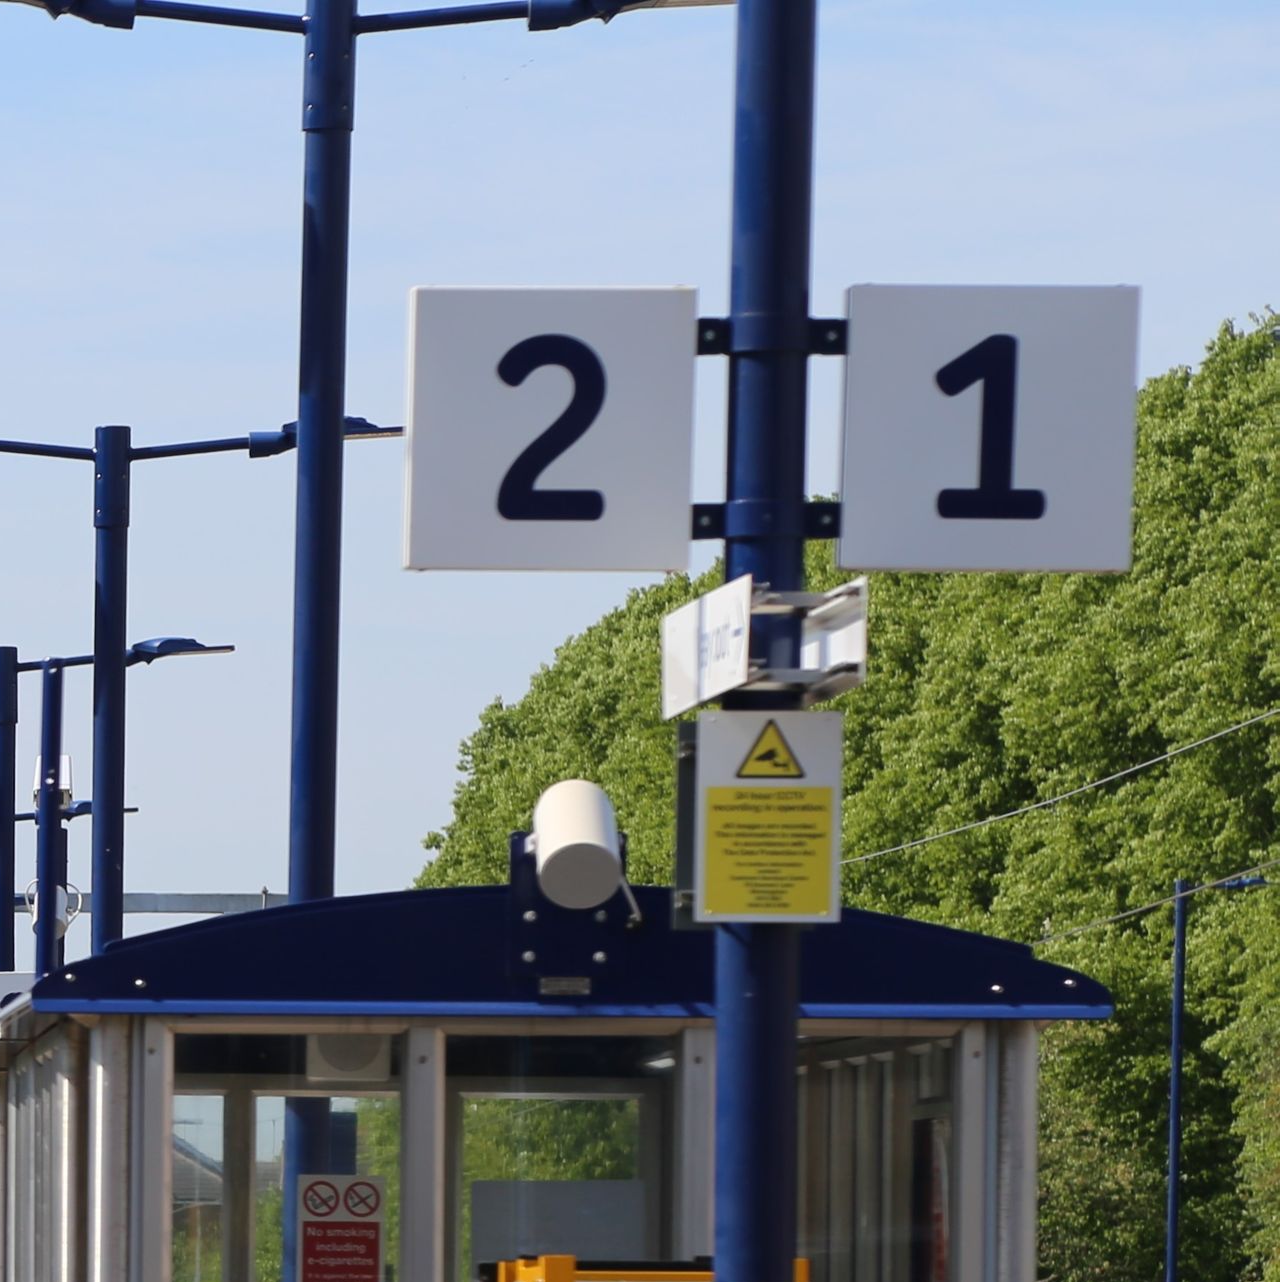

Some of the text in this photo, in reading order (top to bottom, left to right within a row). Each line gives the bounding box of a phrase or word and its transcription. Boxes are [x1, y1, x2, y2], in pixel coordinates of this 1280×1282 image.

[496, 333, 607, 521] 2
[935, 333, 1046, 520] 1
[306, 1227, 376, 1239] No smoking
[315, 1242, 367, 1254] including
[307, 1257, 374, 1267] e-cigarettes
